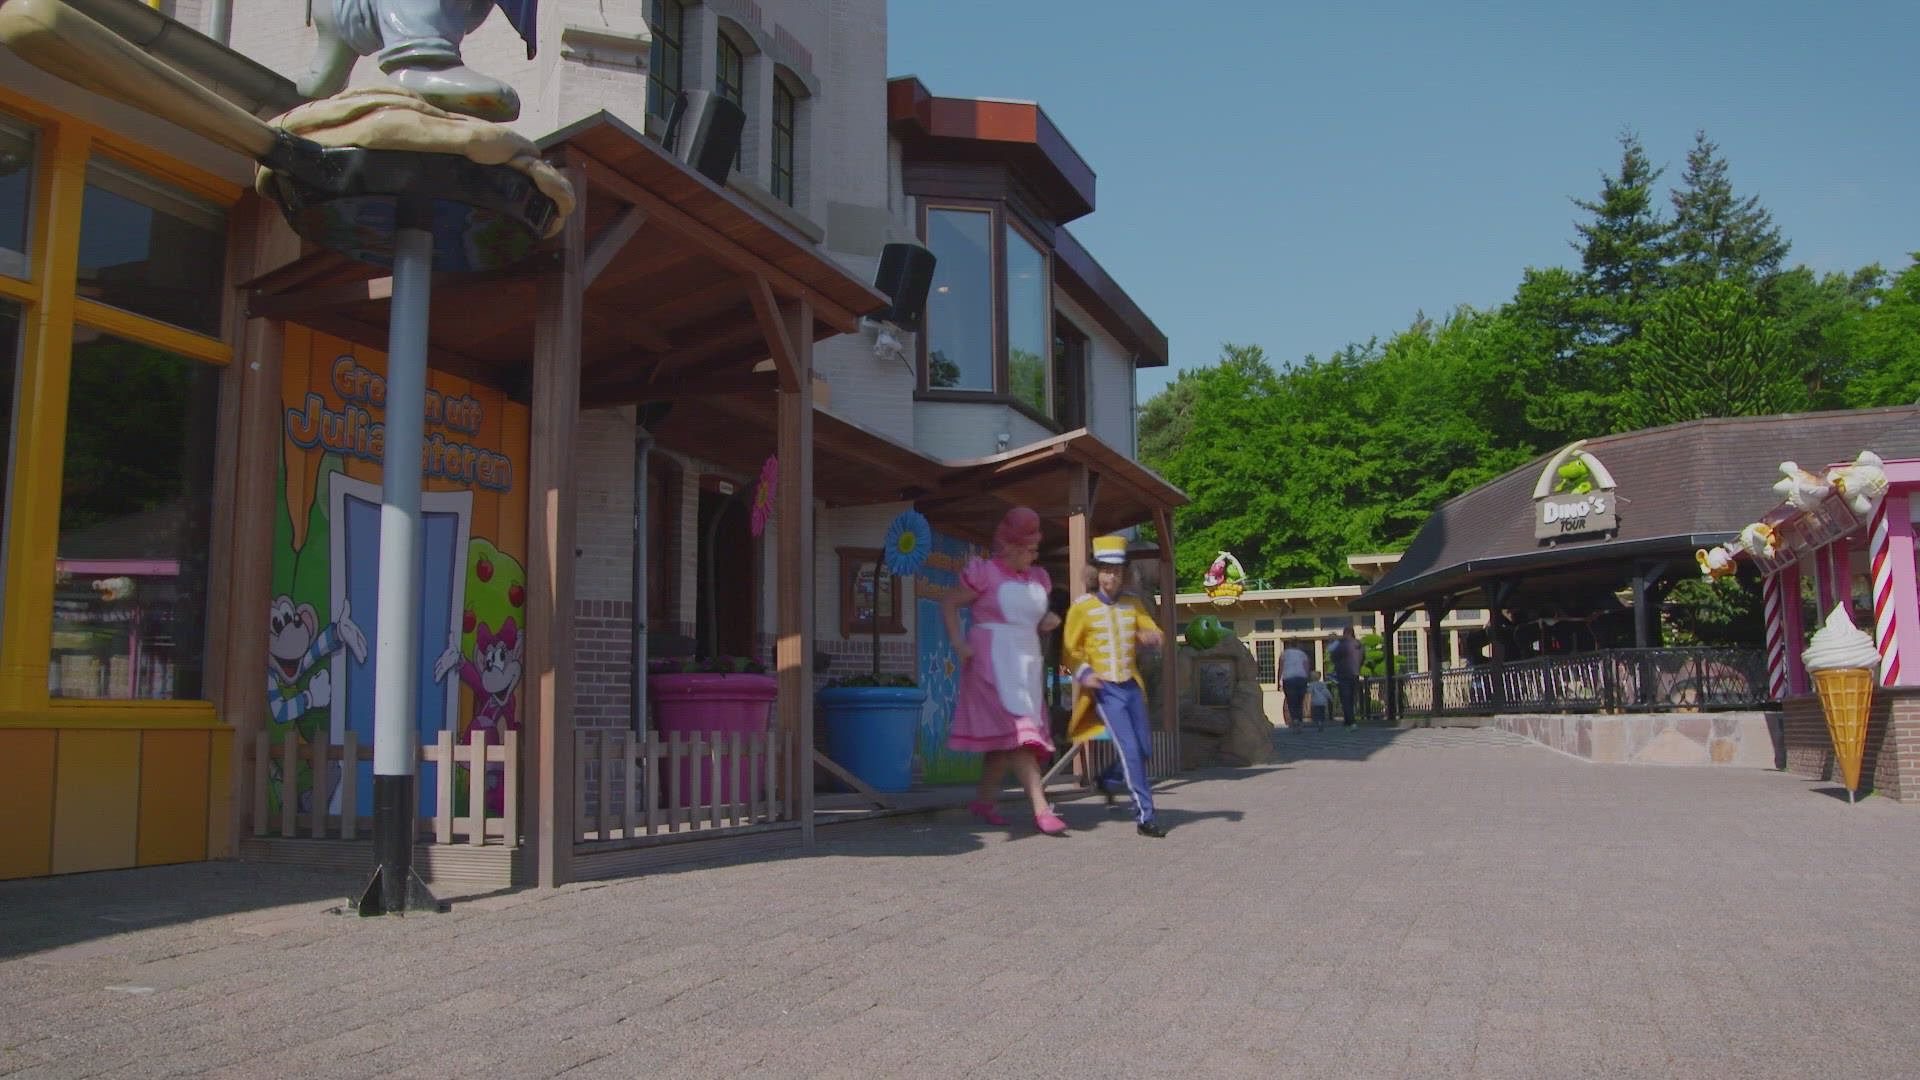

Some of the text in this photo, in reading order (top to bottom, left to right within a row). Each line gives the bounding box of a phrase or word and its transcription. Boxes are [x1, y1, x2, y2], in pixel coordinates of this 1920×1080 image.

[334, 357, 481, 432] Gron uit
[289, 393, 511, 490] Juliatoren
[1560, 518, 1586, 532] TOUR
